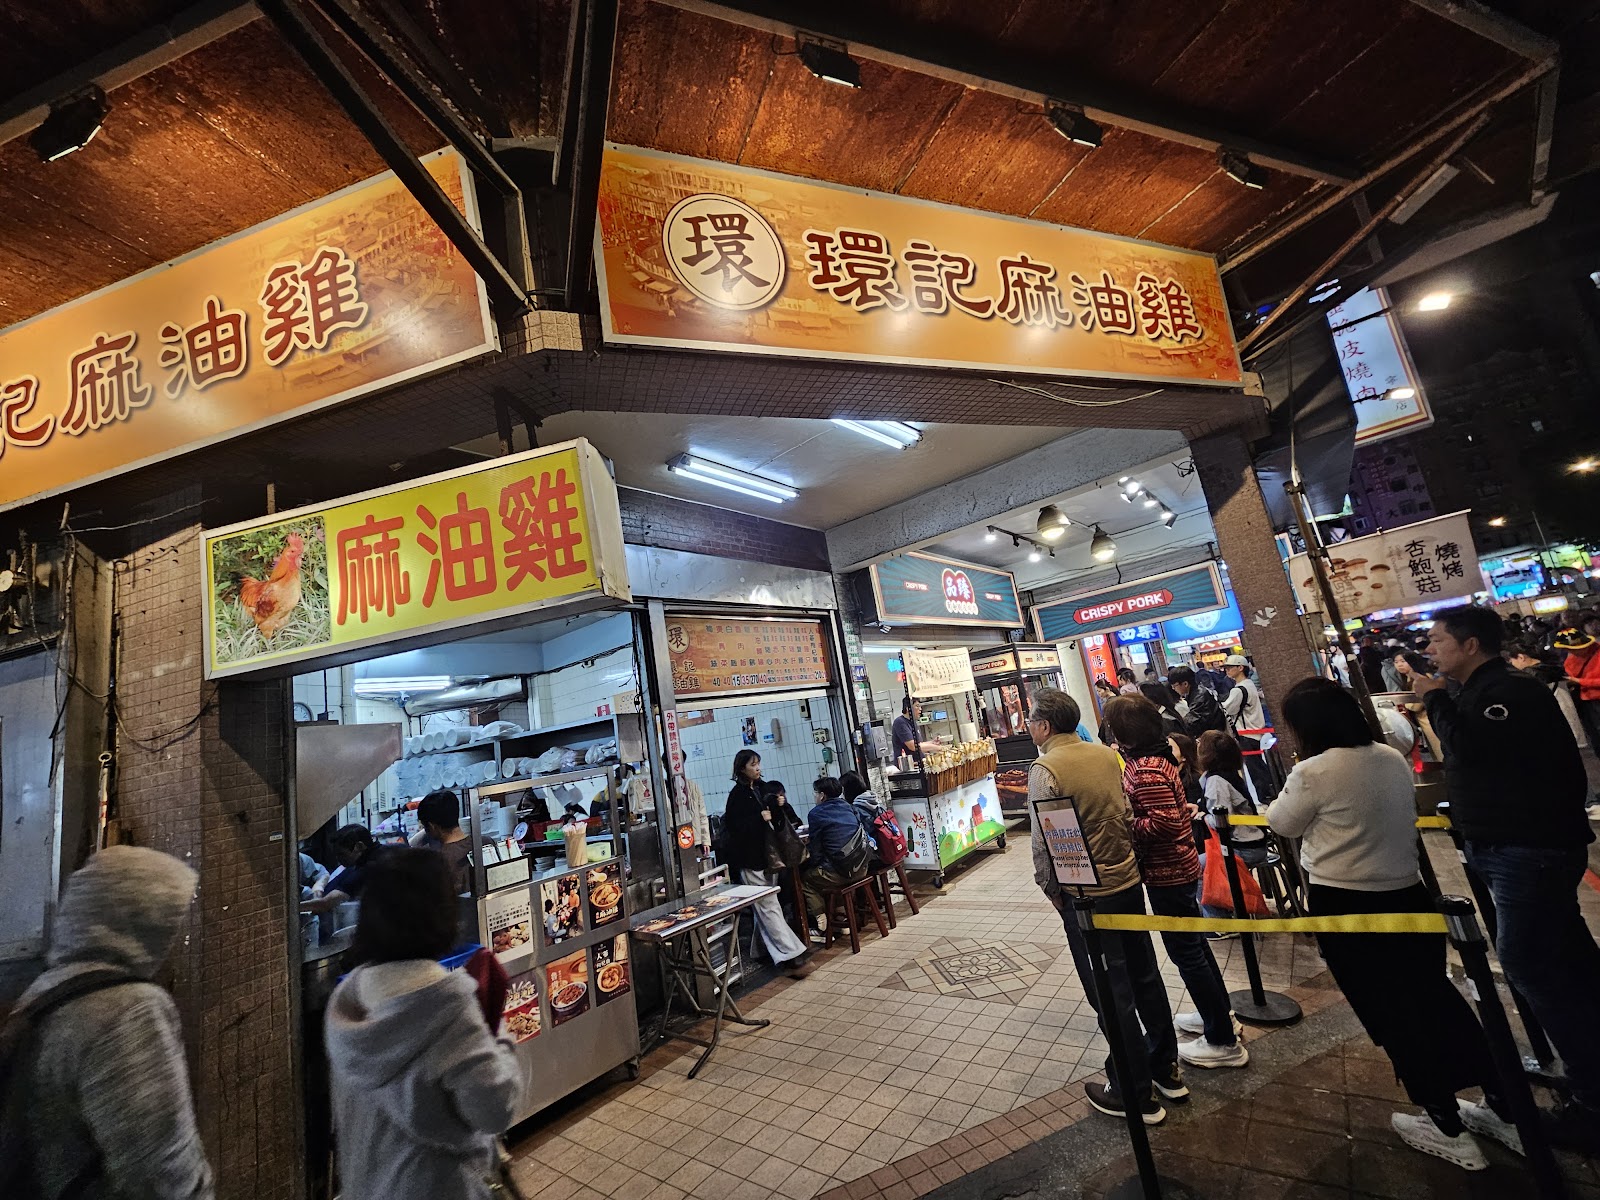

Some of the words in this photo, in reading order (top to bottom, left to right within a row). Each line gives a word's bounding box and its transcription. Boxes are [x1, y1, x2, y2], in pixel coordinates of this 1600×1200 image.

[682, 213, 770, 294] 環
[805, 229, 1202, 340] 環記麻油雞
[336, 468, 587, 625] 麻油雞
[1404, 540, 1441, 595] 杏鮑菇
[1080, 601, 1123, 622] CRISPY
[1127, 593, 1164, 611] PORK
